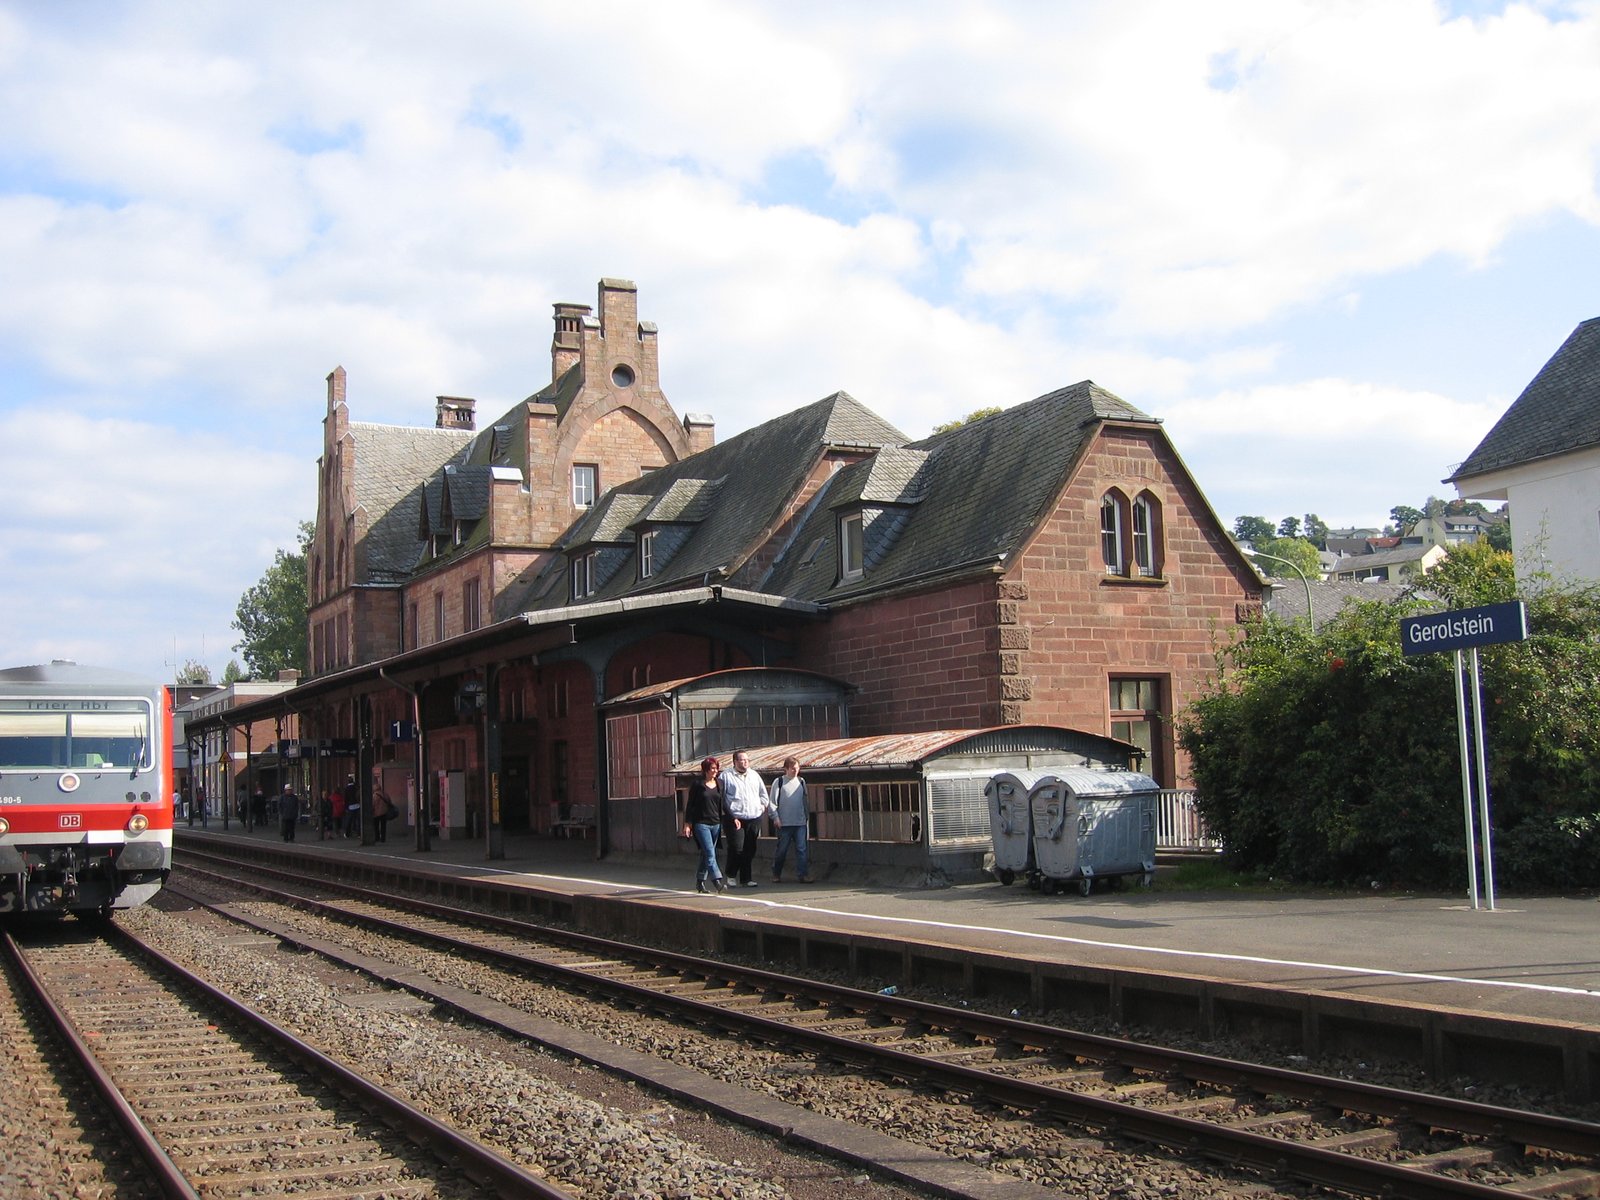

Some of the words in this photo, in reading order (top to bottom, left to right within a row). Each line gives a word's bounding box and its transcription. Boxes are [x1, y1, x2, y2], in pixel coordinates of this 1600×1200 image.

[1409, 614, 1494, 643] Gerolstein
[28, 701, 69, 710] Trier
[81, 701, 109, 710] Hbf
[393, 720, 400, 738] 1
[61, 816, 79, 826] DB
